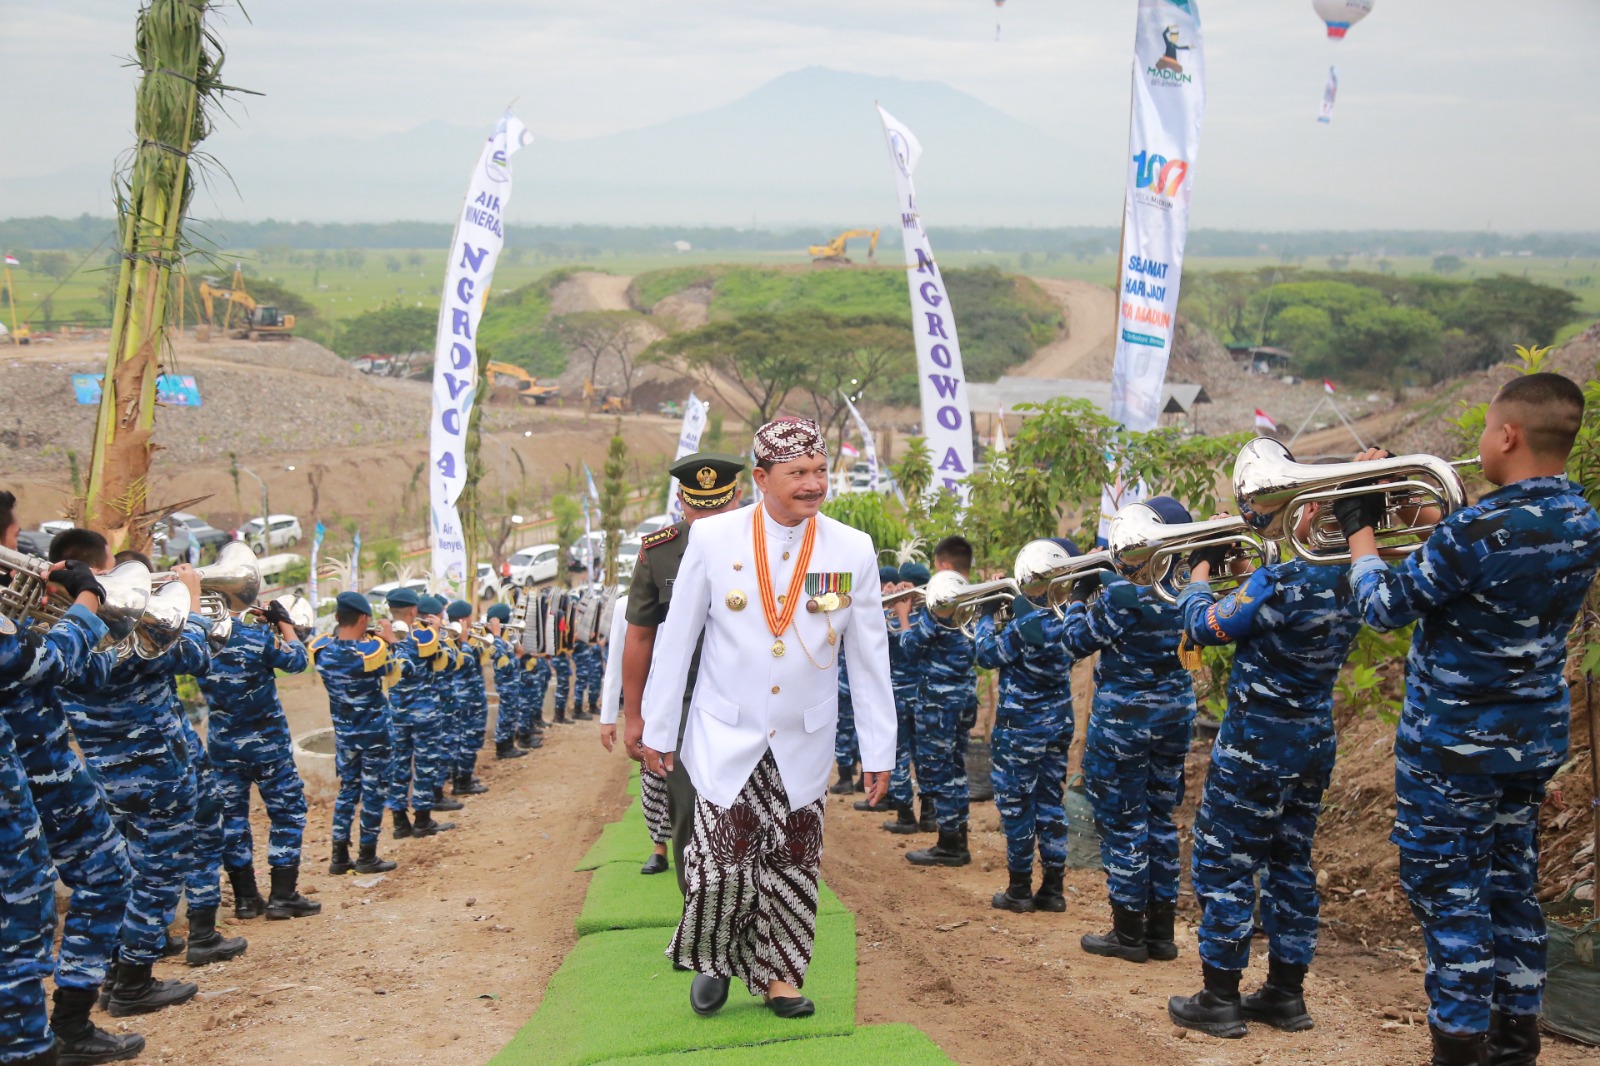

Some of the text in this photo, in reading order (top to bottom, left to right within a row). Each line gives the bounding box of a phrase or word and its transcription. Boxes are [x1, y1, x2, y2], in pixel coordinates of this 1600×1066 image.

[1147, 66, 1192, 84] MADIUN
[1125, 277, 1167, 303] HARI JADI
[443, 523, 453, 535] Air
